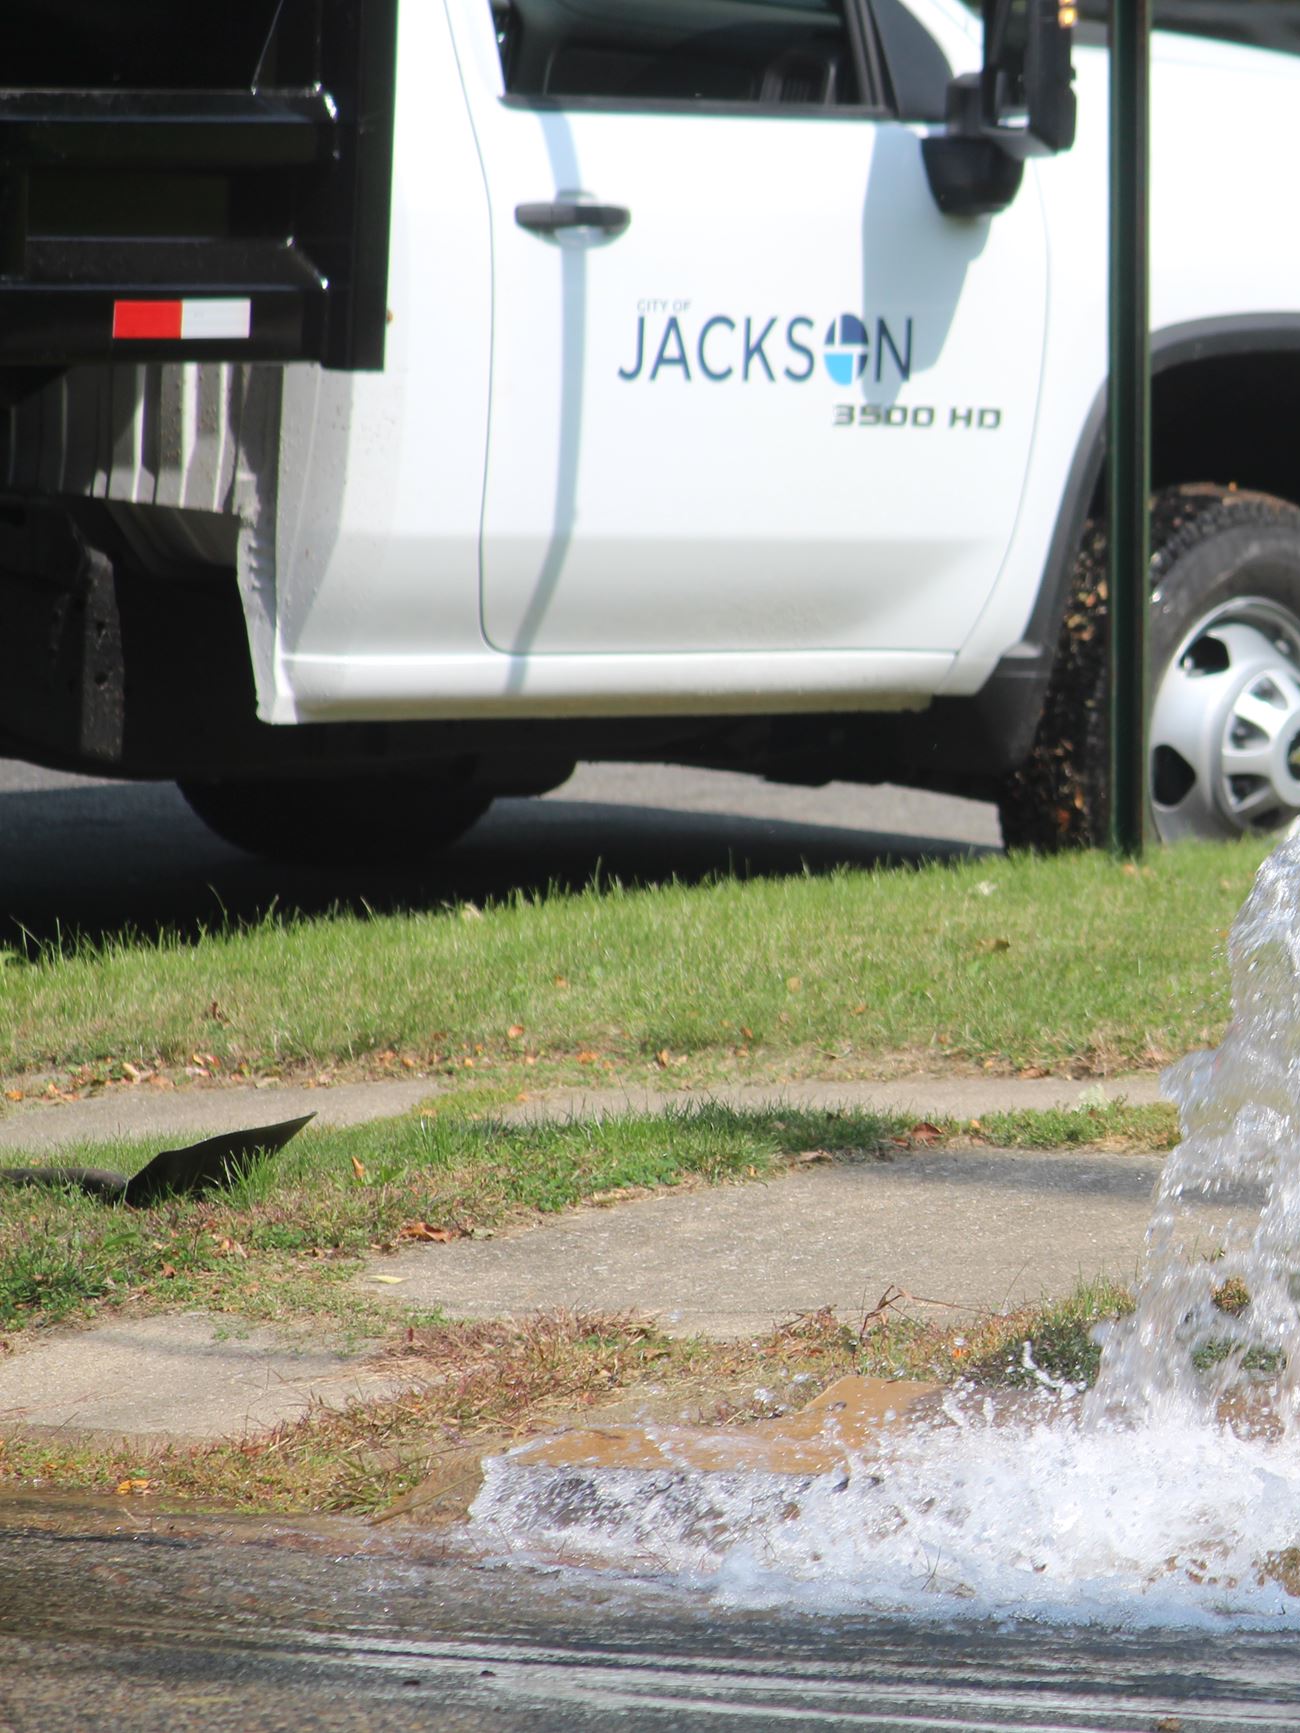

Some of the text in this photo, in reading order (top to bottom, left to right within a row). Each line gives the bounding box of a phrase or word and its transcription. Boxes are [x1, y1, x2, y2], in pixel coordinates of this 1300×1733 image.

[637, 299, 692, 313] CITY OF
[618, 313, 913, 386] JACKSON
[833, 404, 1002, 429] 3500 HD
